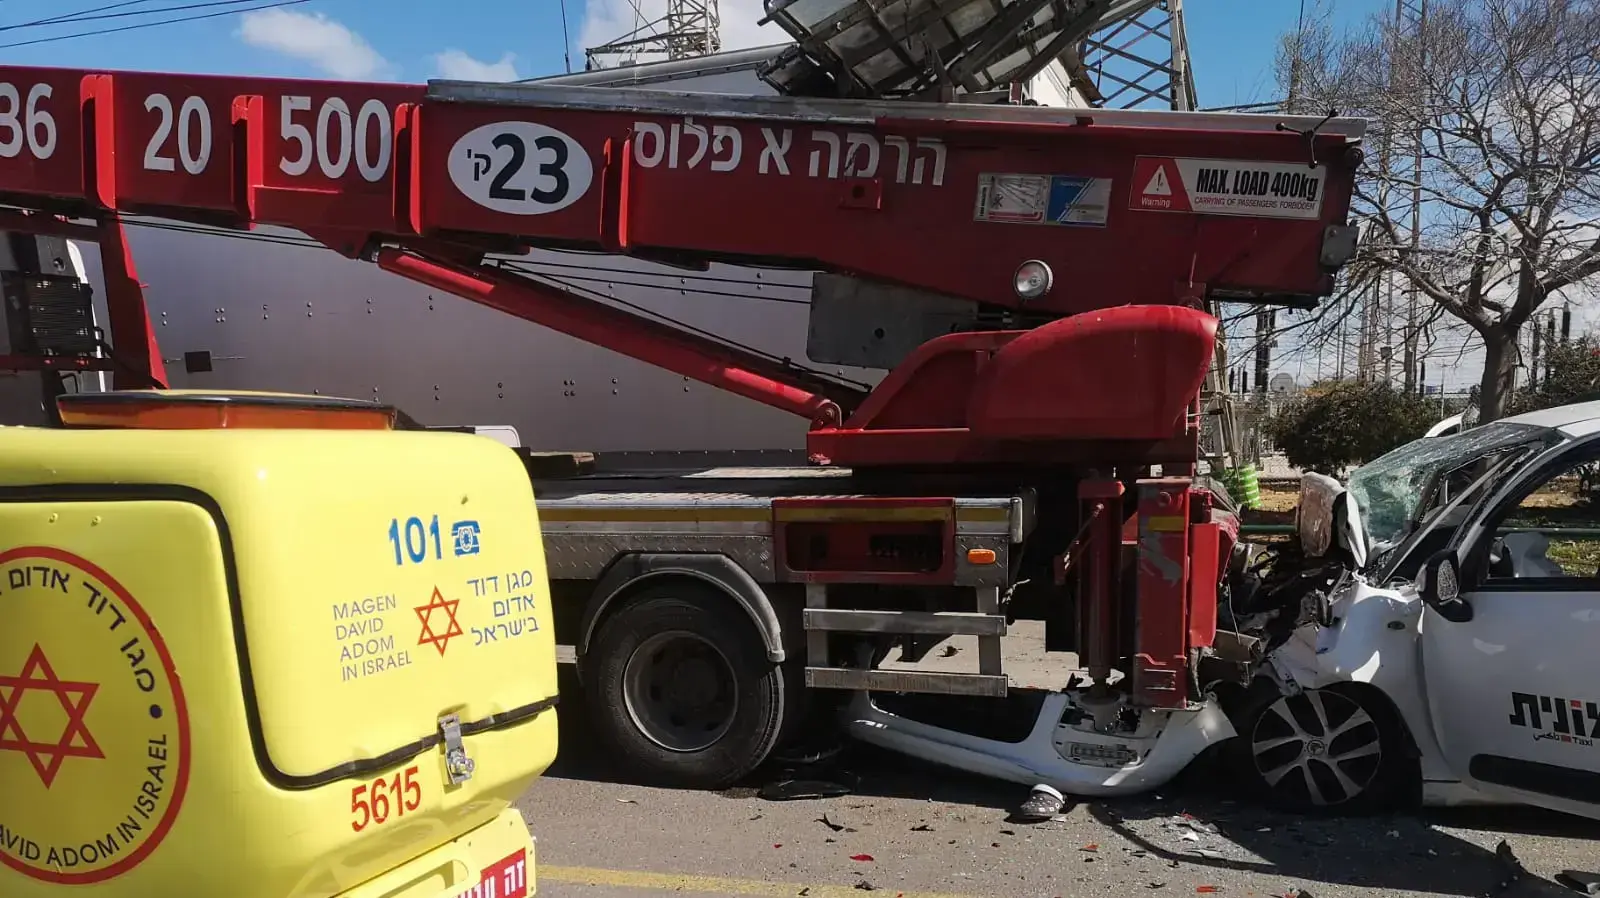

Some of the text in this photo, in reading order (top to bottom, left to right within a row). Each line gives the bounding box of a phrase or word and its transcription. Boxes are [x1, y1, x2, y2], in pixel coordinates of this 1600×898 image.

[143, 93, 212, 175] 20
[279, 95, 392, 182] 500
[633, 116, 948, 186] הרמה א פלוס
[488, 131, 570, 205] 23
[1196, 168, 1319, 202] MAX. LOAD 400kg
[1141, 196, 1171, 209] Warning
[1194, 196, 1316, 211] CARRYING OF PASSENGERS FORBIDDEN
[388, 514, 443, 566] 101
[467, 570, 533, 597] מגן דוד
[332, 594, 397, 621] MAGEN
[493, 594, 536, 618] אדום
[8, 566, 156, 694] מגן דוד אדום
[335, 617, 384, 641] DAVID
[471, 616, 540, 646] בישראל
[340, 635, 395, 662] ADOM
[342, 650, 413, 682] IN ISRAEL
[1572, 736, 1593, 747] Taxi
[46, 833, 121, 868] ADOM
[115, 815, 143, 844] IN
[133, 733, 167, 820] ISRAEL
[351, 765, 422, 833] 5615
